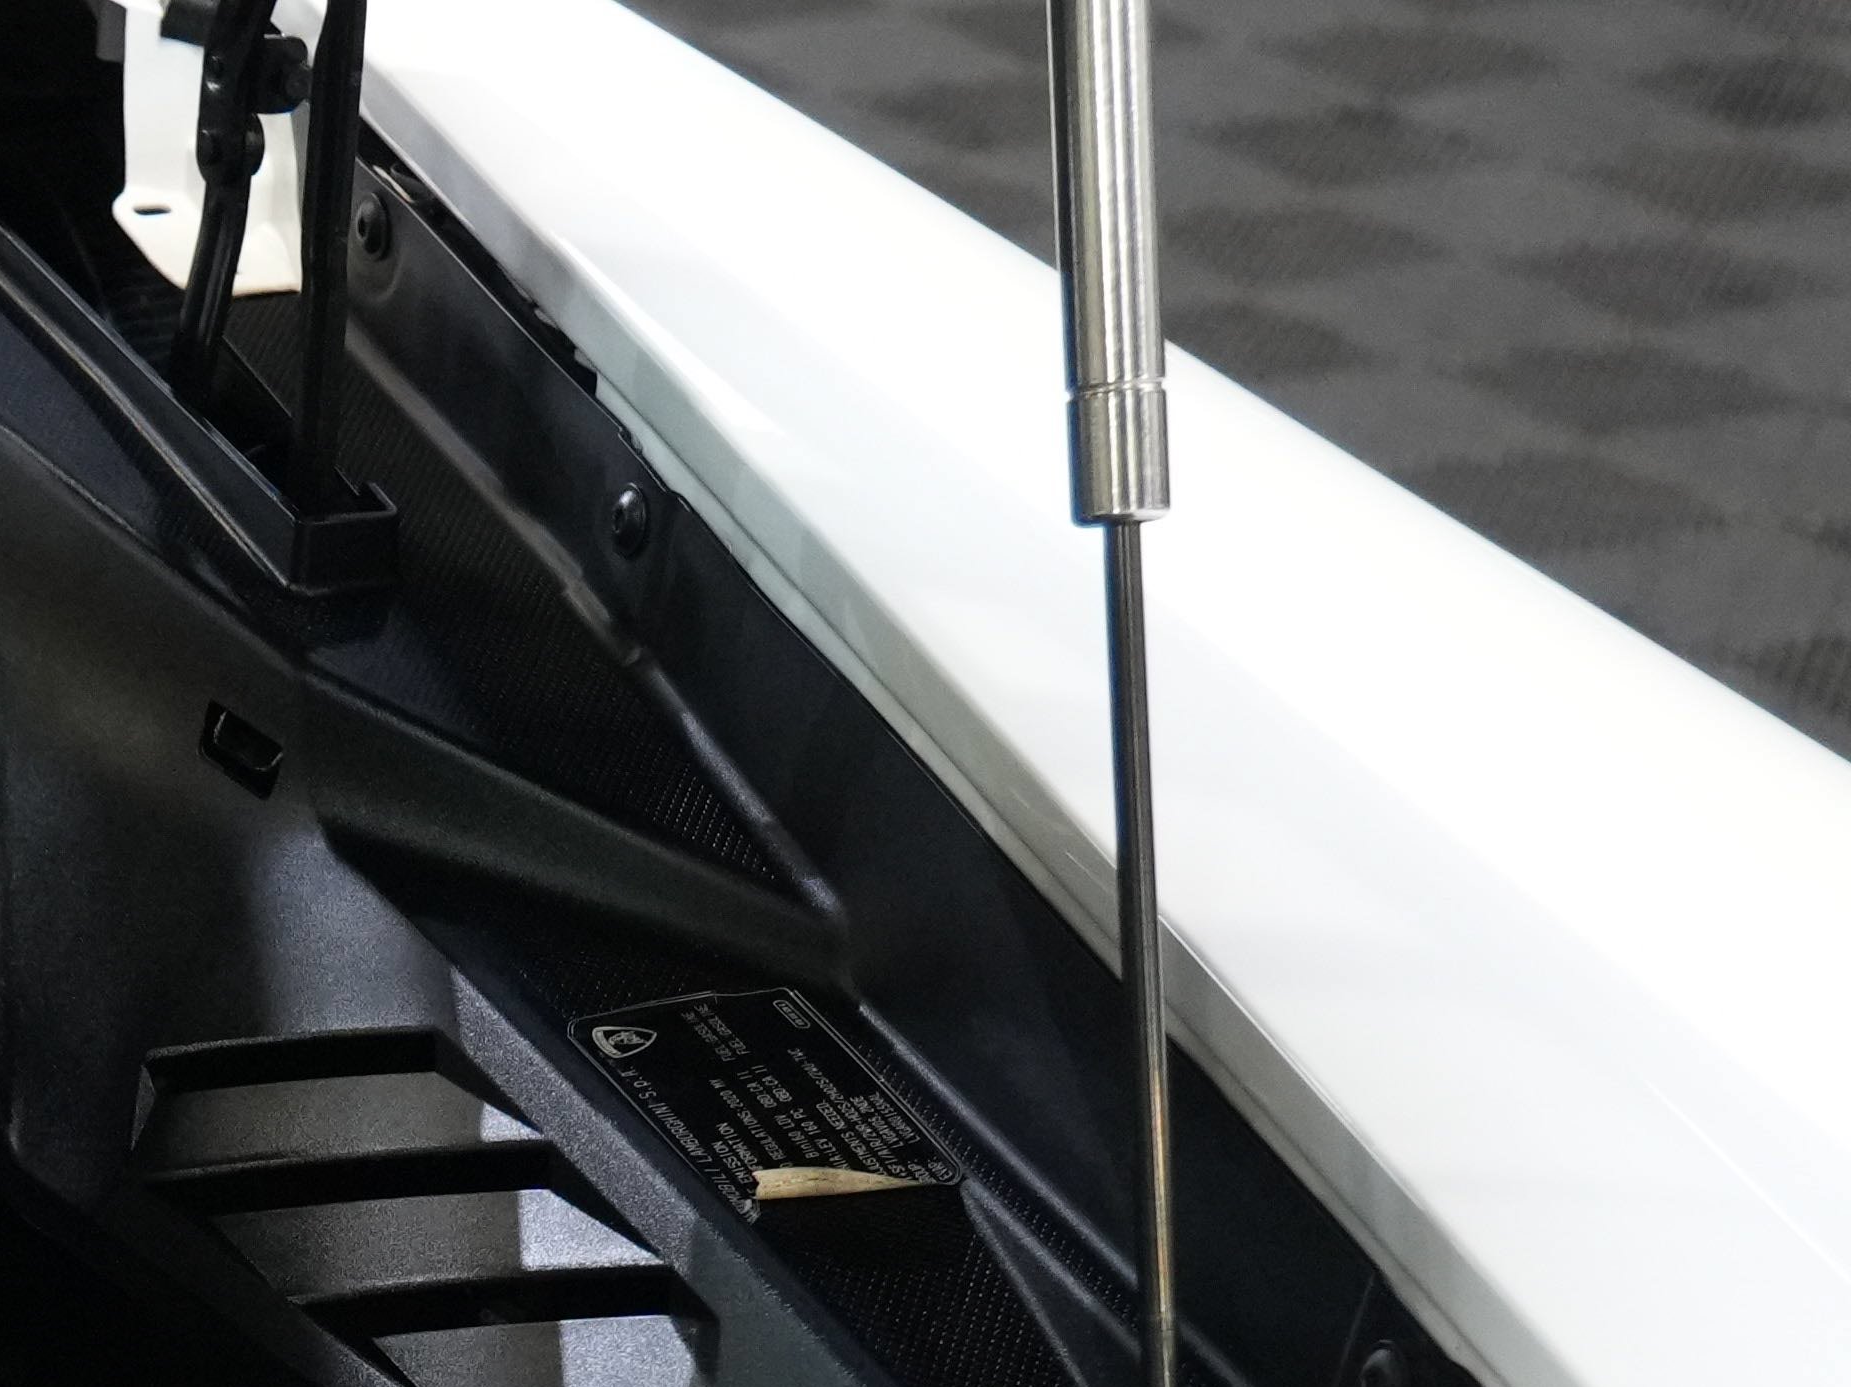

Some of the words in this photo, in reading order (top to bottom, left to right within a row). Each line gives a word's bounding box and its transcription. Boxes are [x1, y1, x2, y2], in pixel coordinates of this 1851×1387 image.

[617, 1066, 657, 1100] S.p.A.
[647, 1102, 713, 1163] LAMBORGHINI
[715, 1122, 764, 1172] FORMATION
[711, 1140, 754, 1184] EMISSION
